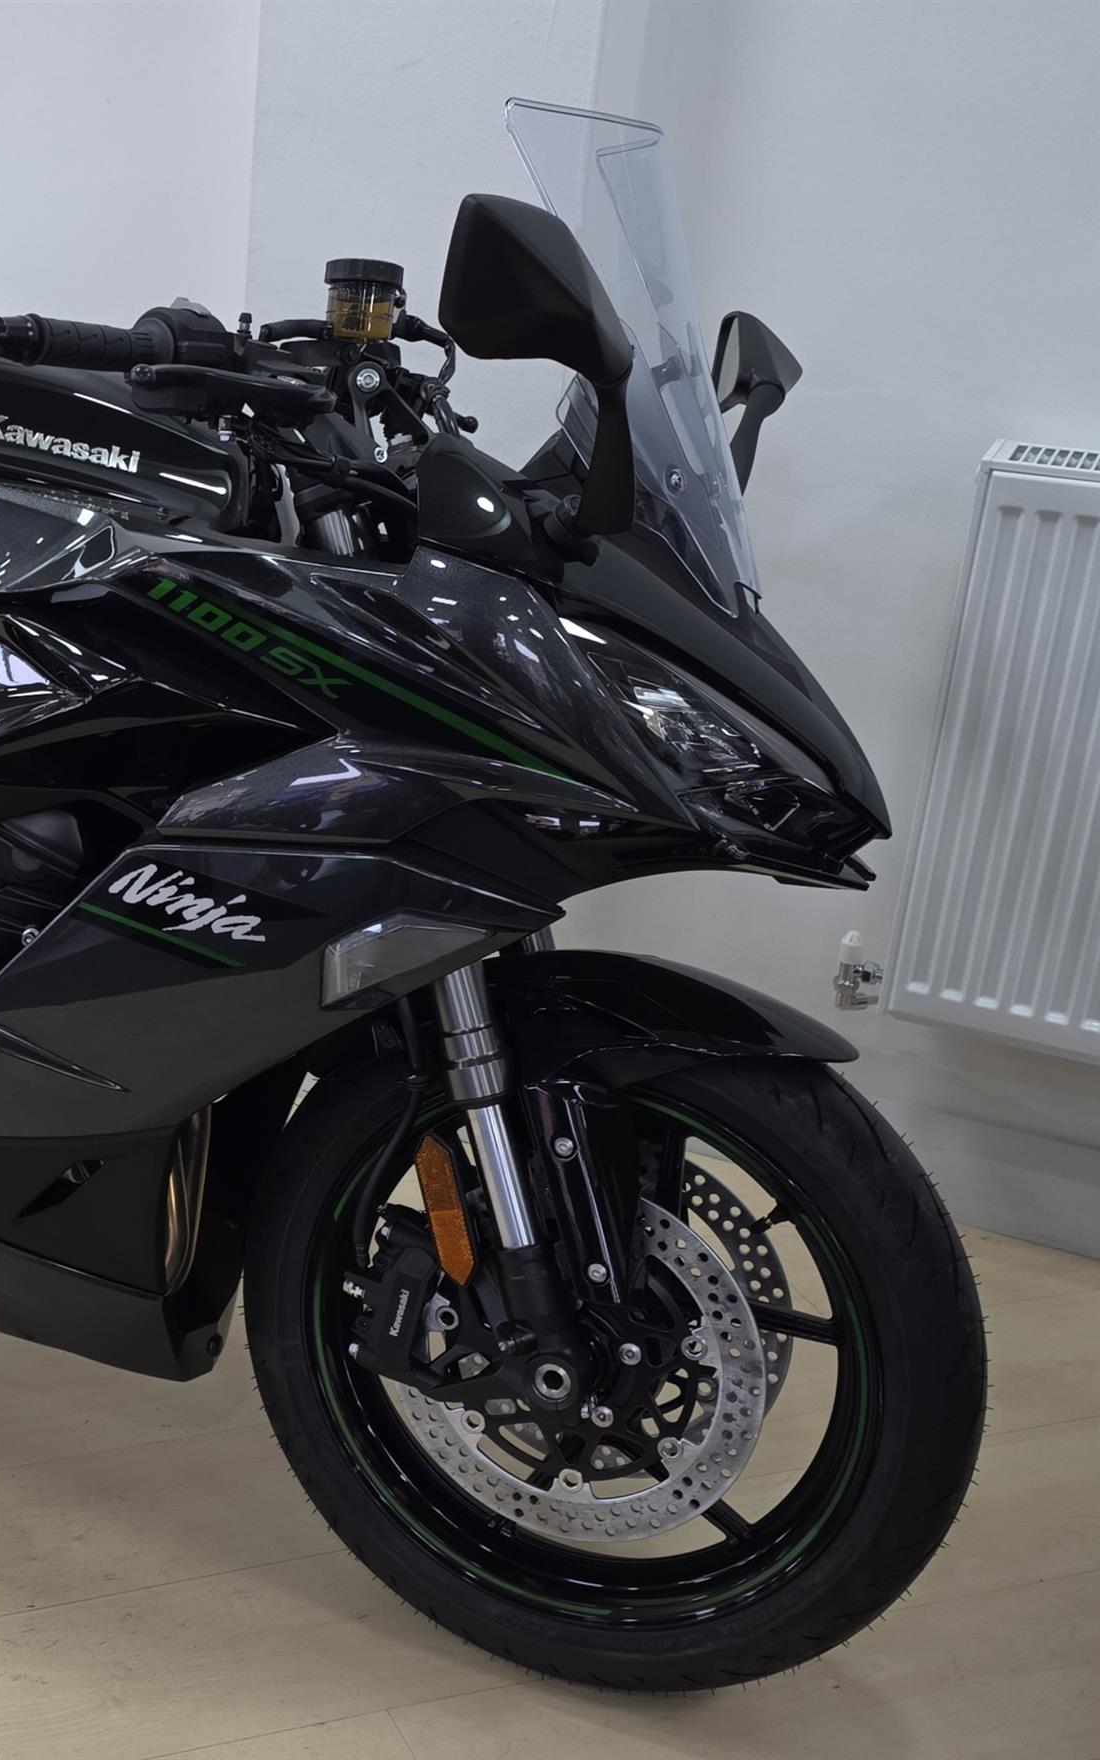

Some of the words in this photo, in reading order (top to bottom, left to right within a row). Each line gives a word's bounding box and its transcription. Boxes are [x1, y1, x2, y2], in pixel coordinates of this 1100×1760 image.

[147, 577, 268, 653] 1100
[260, 646, 354, 700] SX
[108, 863, 267, 943] Ninja
[389, 1289, 410, 1337] Kawasaki
